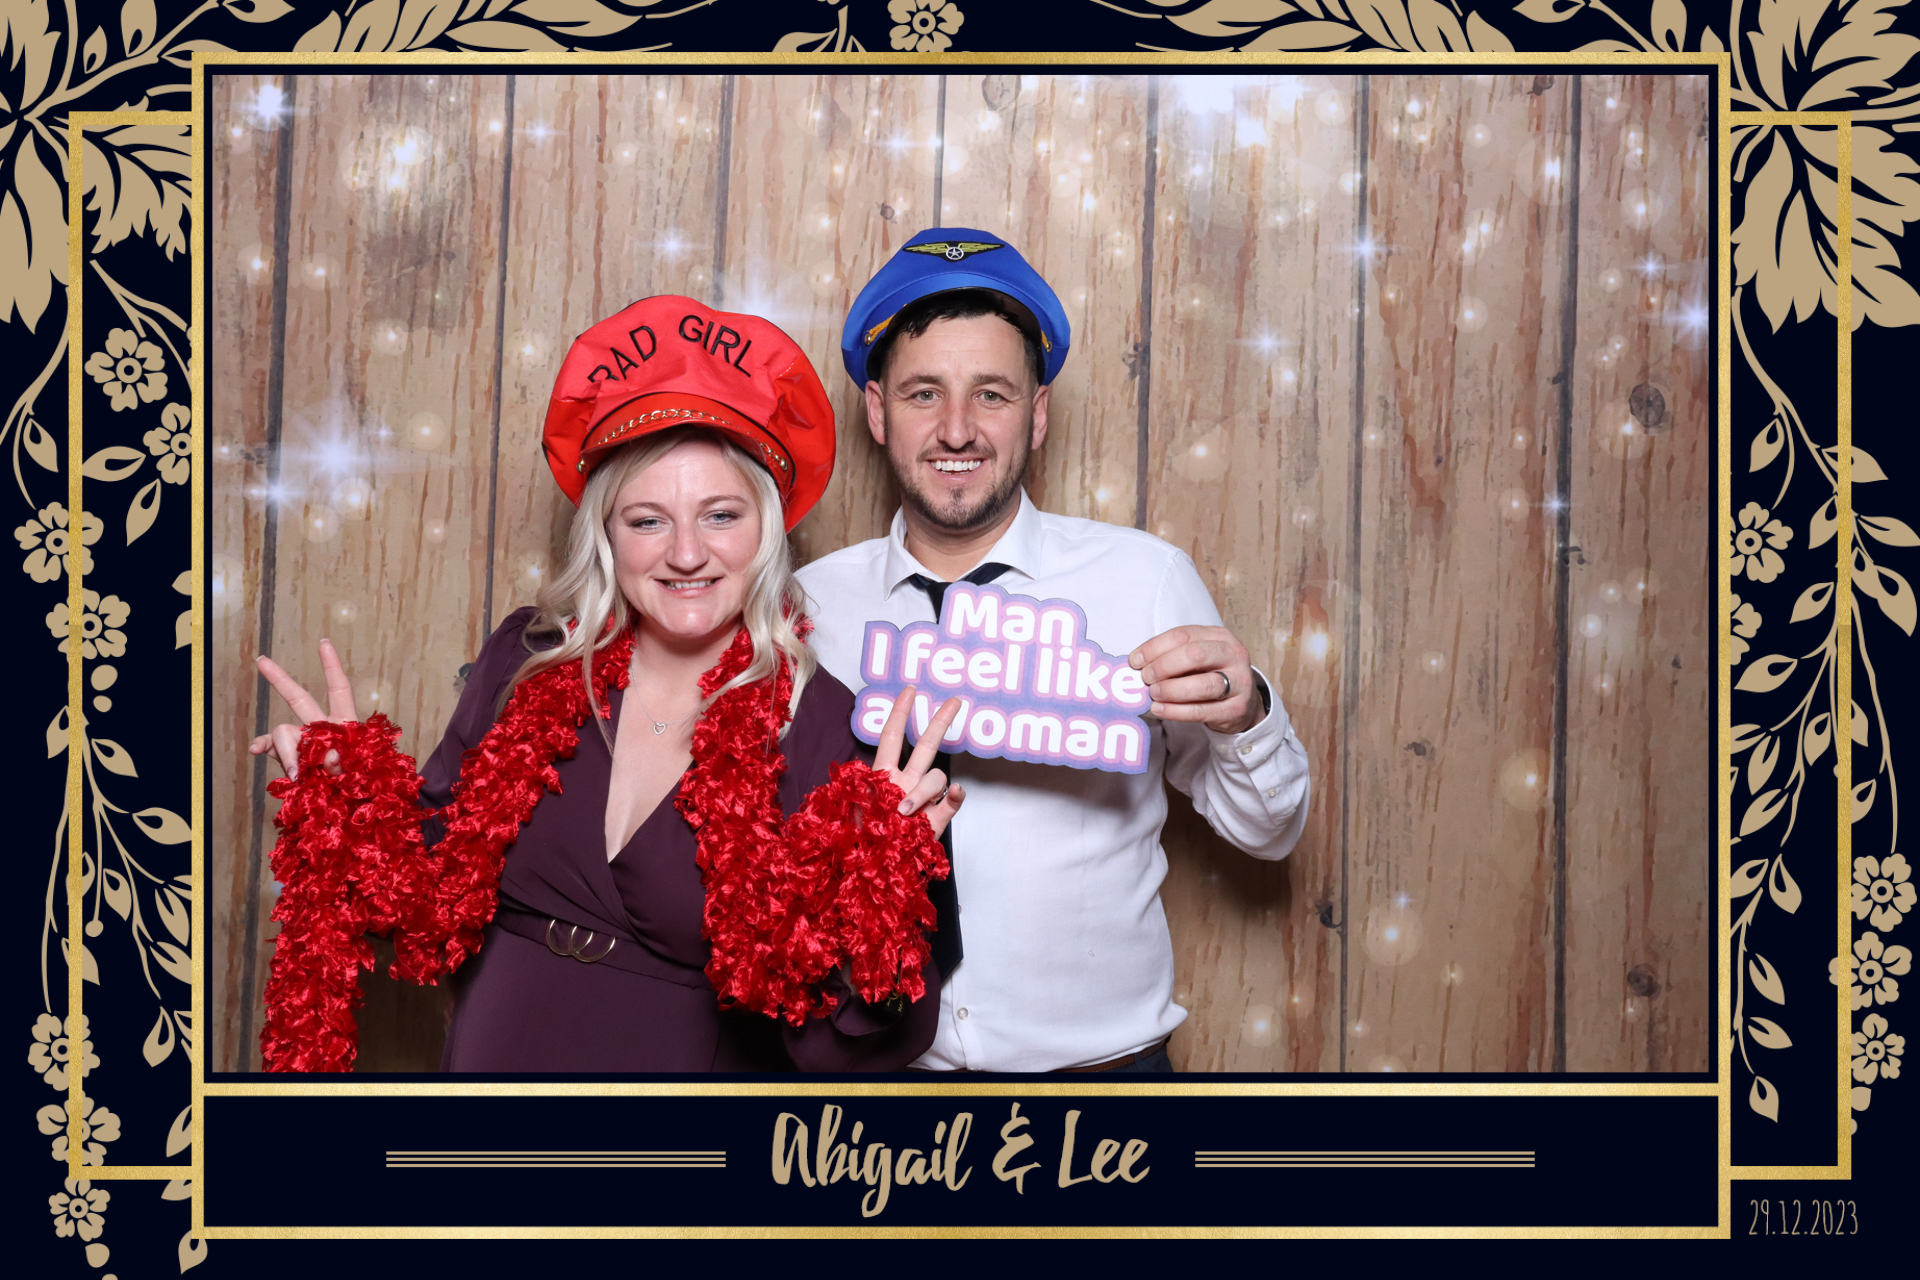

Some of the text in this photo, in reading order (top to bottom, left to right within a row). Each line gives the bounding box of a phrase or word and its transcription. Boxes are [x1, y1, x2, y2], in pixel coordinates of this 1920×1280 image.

[678, 314, 753, 378] GIRL
[949, 592, 1075, 646] Man
[870, 632, 1143, 704] I feel like
[862, 697, 895, 734] a
